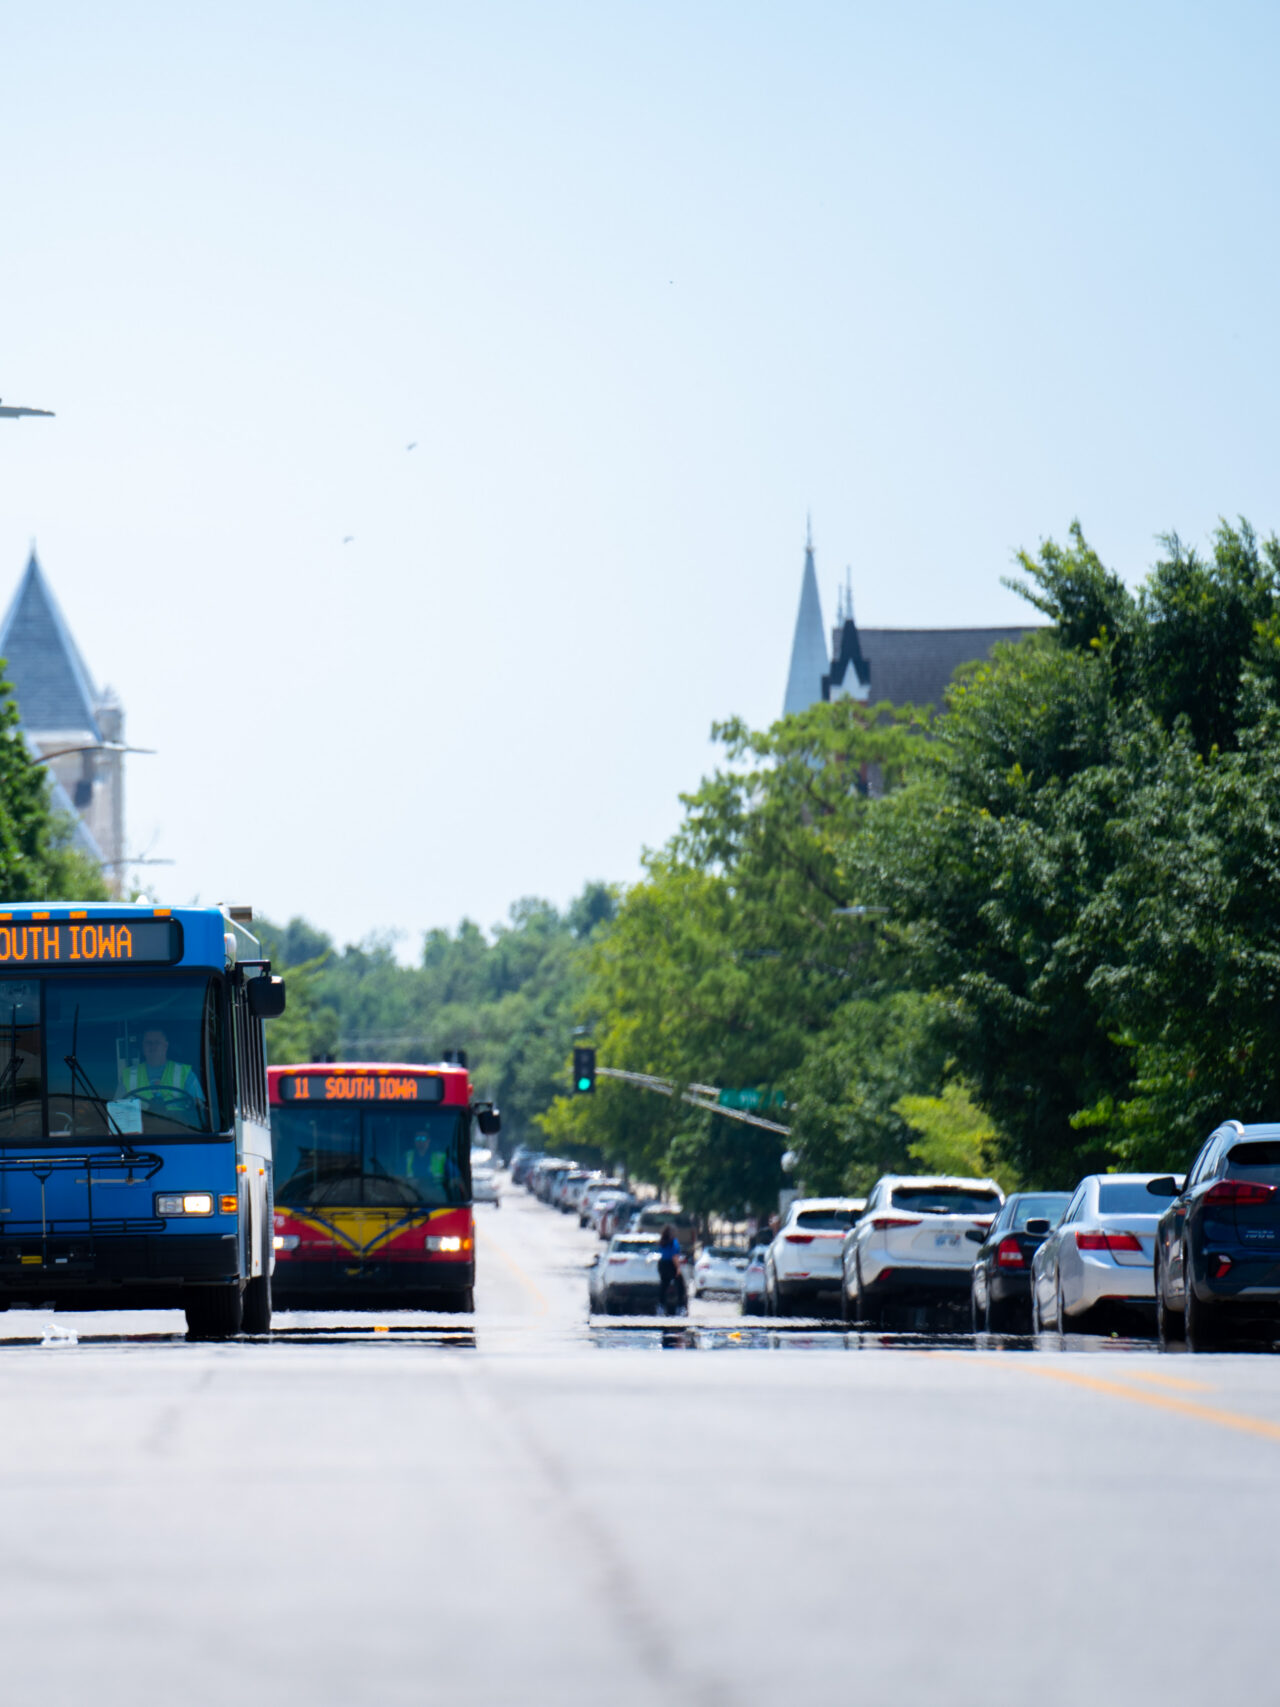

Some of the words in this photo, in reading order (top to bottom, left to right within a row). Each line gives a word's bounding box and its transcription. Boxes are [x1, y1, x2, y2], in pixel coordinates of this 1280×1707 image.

[69, 925, 132, 959] IOWA
[294, 1077, 310, 1099] 11
[325, 1077, 375, 1099] SOUTH
[378, 1078, 418, 1099] IOWA
